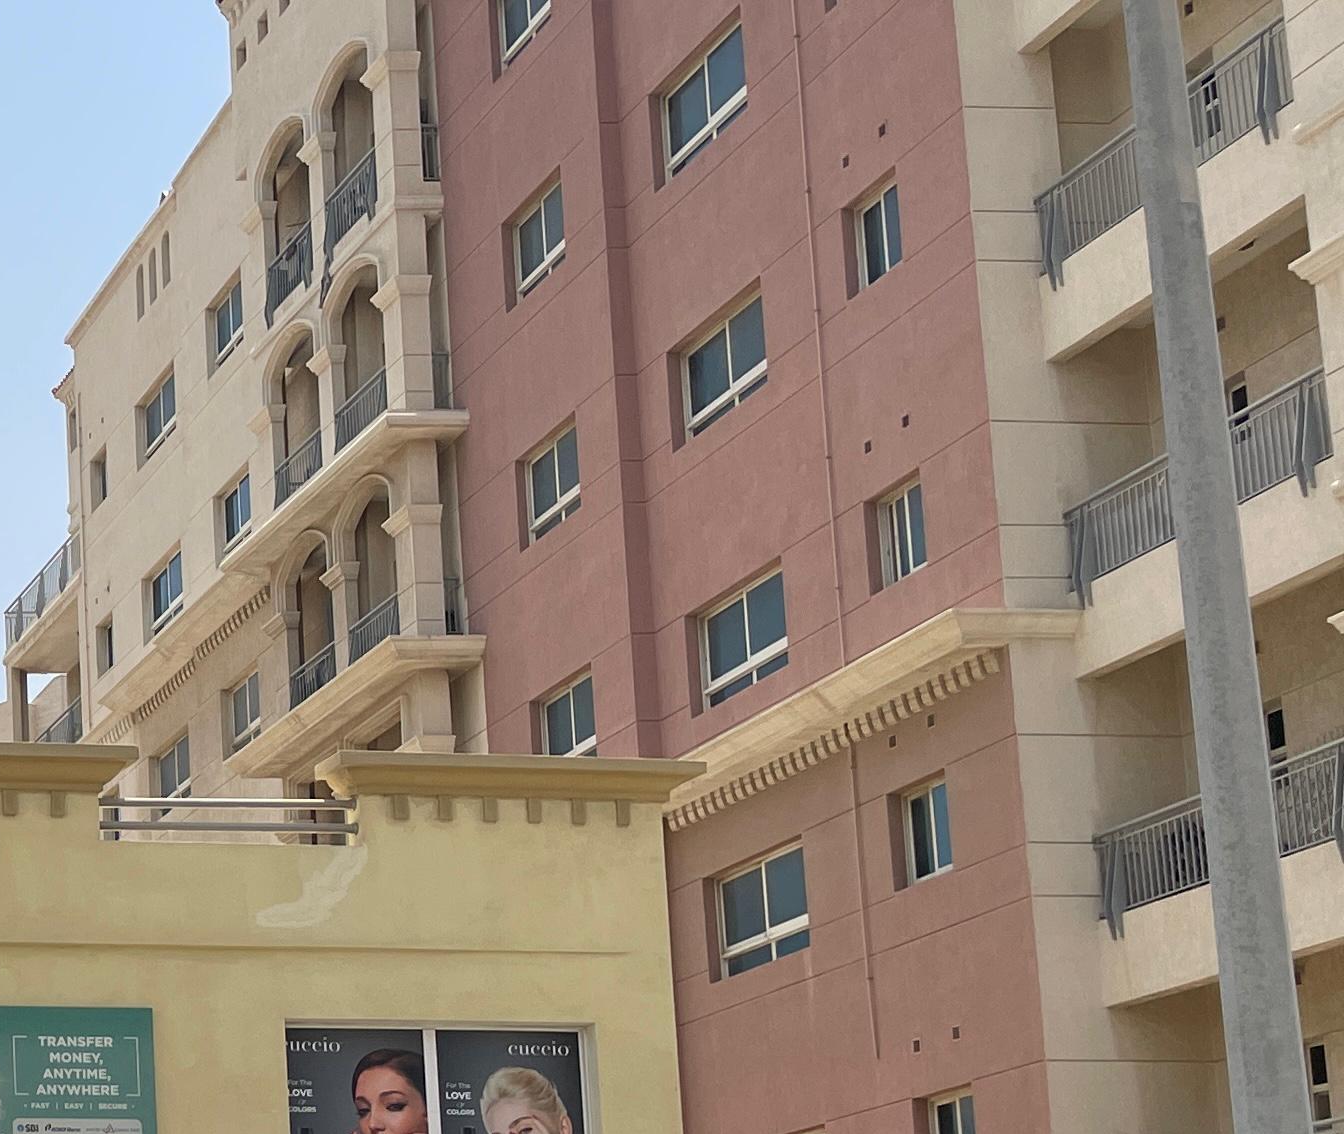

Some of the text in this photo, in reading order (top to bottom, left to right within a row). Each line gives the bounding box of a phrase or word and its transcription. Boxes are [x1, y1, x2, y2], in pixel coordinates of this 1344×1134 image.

[37, 1036, 113, 1047] TRANSFER
[284, 1036, 341, 1052] uccio
[508, 1040, 570, 1056] cuccio
[49, 1052, 103, 1065] MONEY,
[43, 1068, 112, 1081] ANYTIME,
[36, 1084, 120, 1096] ANYWHERE
[445, 1091, 472, 1100] LOVE
